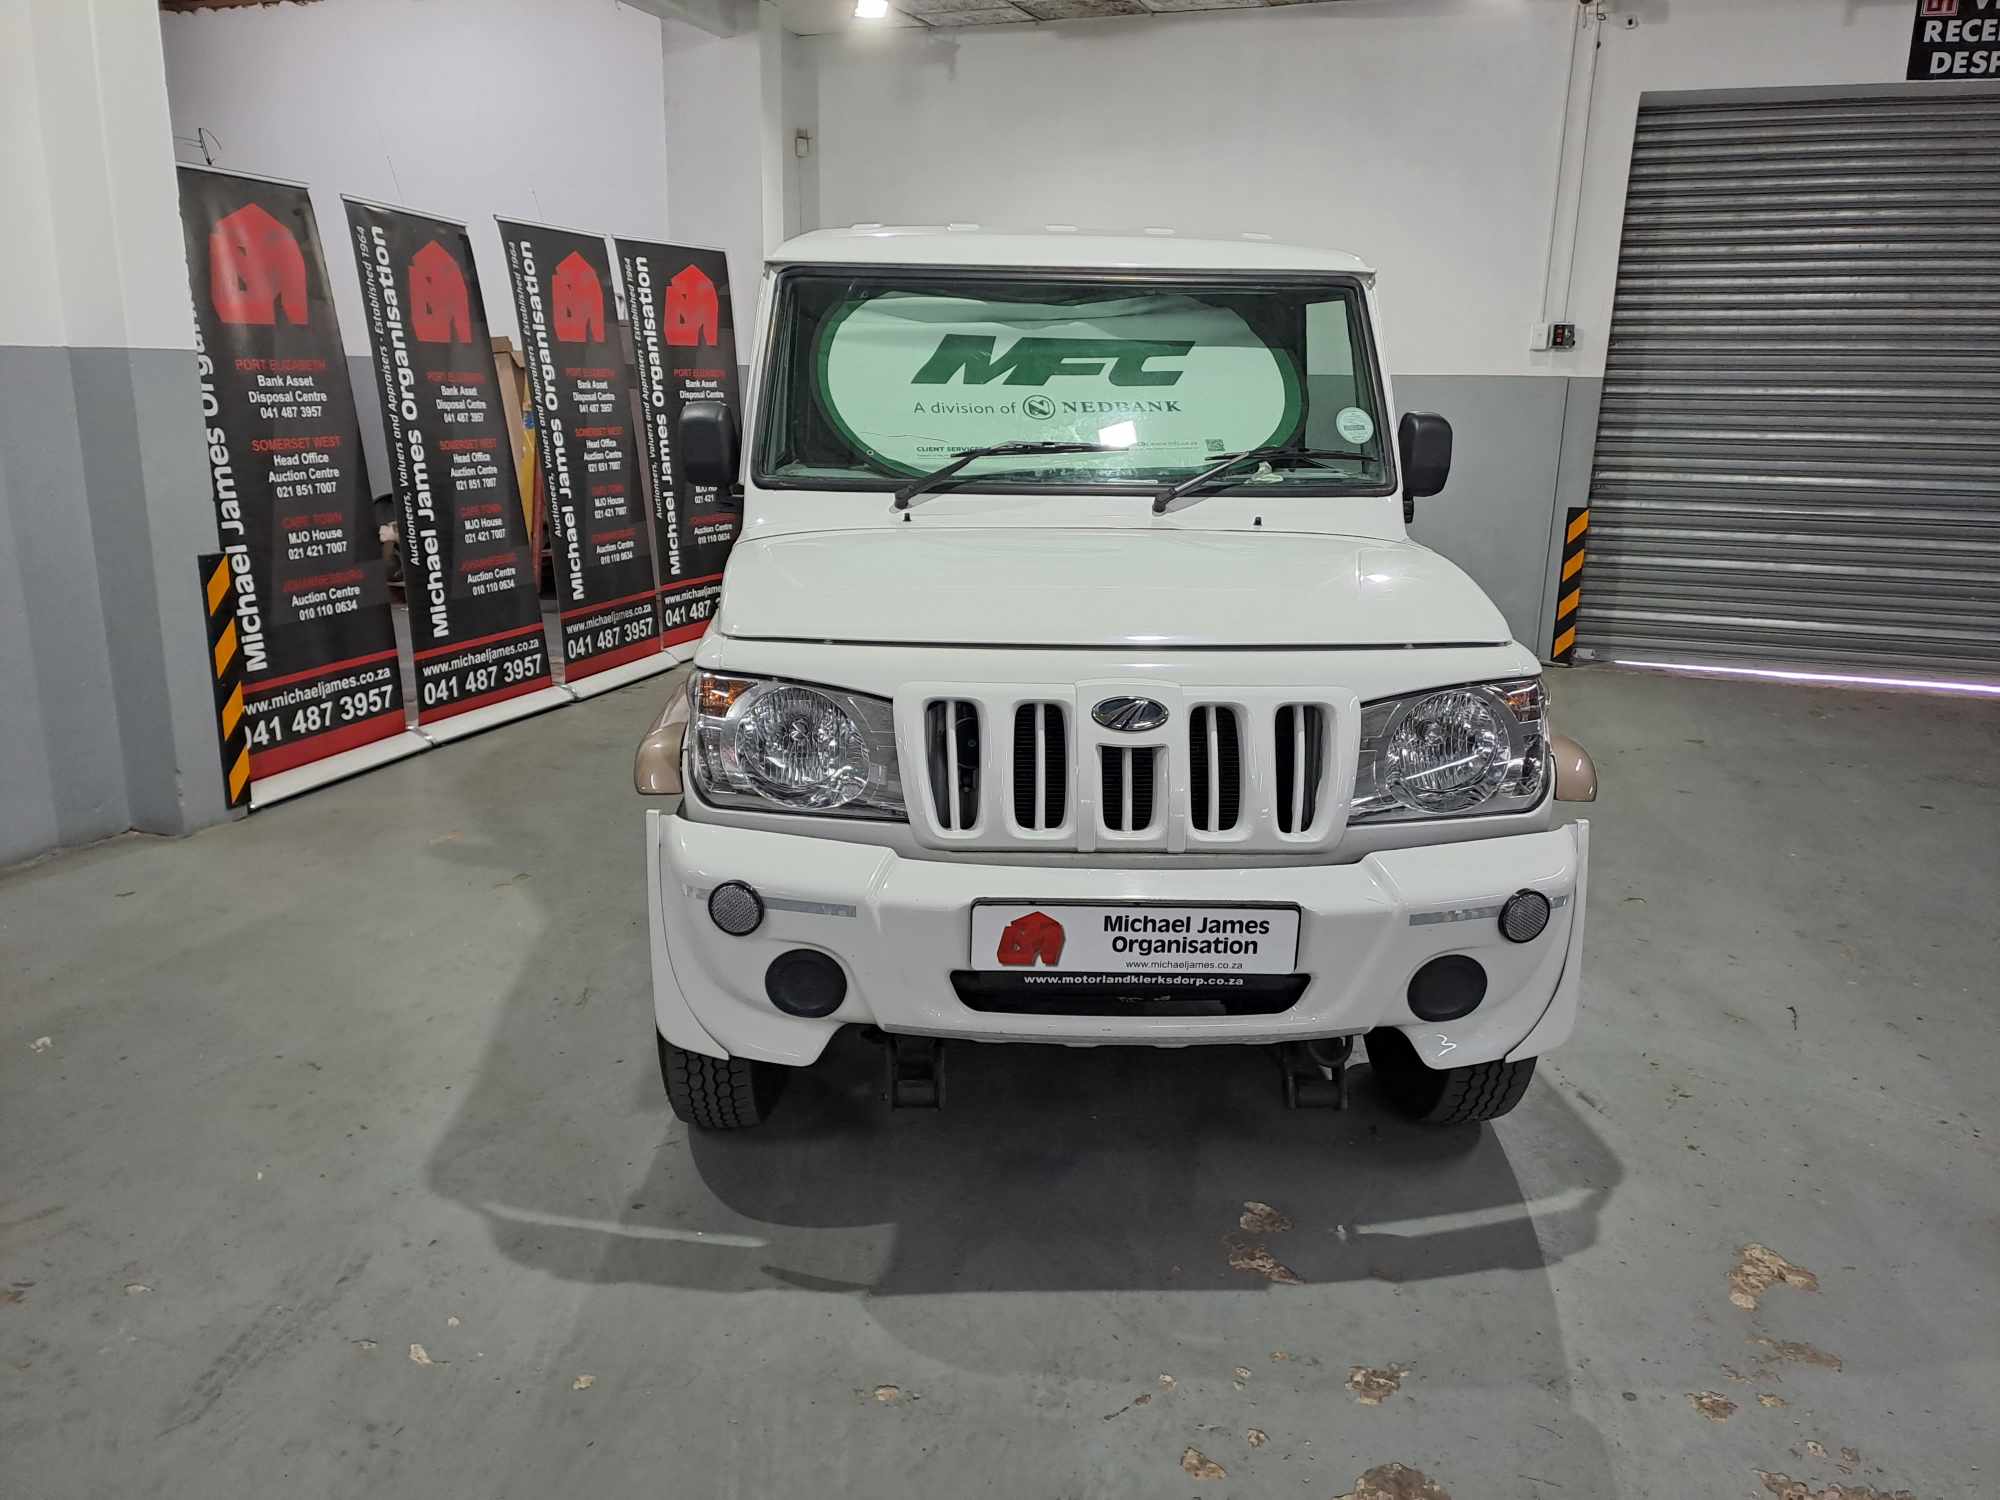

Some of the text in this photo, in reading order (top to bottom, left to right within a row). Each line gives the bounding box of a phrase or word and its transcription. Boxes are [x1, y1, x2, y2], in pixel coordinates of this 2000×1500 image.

[1923, 19, 2000, 42] RECE
[910, 333, 1196, 386] MFC
[257, 375, 314, 387] Bank Asset
[440, 385, 459, 396] Bank
[248, 390, 328, 405] Disposal Centre
[356, 225, 420, 566] Auctioneers, Valuers and Appraisers Established 1964
[260, 405, 322, 419] 041 487 3957
[636, 256, 681, 575] Michael James Organisation
[913, 400, 1182, 414] A division of NEDBANK
[520, 240, 585, 600] Michael James Organisation
[371, 225, 449, 638] Michael James Organisation
[251, 435, 342, 452] SOMERSET WEST
[273, 452, 329, 466] Head Office
[453, 452, 491, 463] Head Office
[268, 467, 340, 483] Auction Centre
[451, 465, 498, 477] Auction Centre
[276, 482, 336, 498] 021 851 7007
[288, 528, 343, 544] MJO House
[206, 427, 268, 673] Michael James
[288, 541, 347, 560] 021 421 7007
[467, 567, 516, 584] Auction Centre
[291, 586, 361, 608] Auction Centre
[664, 585, 722, 605] www.michaeljame
[299, 599, 358, 621] 010 110 0634
[566, 603, 652, 635] www.michaeljames.co.za
[665, 606, 686, 626] 041
[689, 600, 711, 619] 487
[567, 617, 653, 659] 041 487 3957
[422, 638, 540, 677] www.michaeljames.co.za
[424, 653, 542, 705] 041 487 3957
[244, 667, 391, 716] ww.michaeljames.co.za
[291, 701, 334, 734] 487
[339, 684, 393, 721] 3957
[1104, 915, 1270, 934] Michael James
[1112, 935, 1258, 956] Organisation
[1125, 960, 1243, 971] www.michaeljames.co.za
[1024, 974, 1244, 987] www.motorlandklerksdorp.co.za
